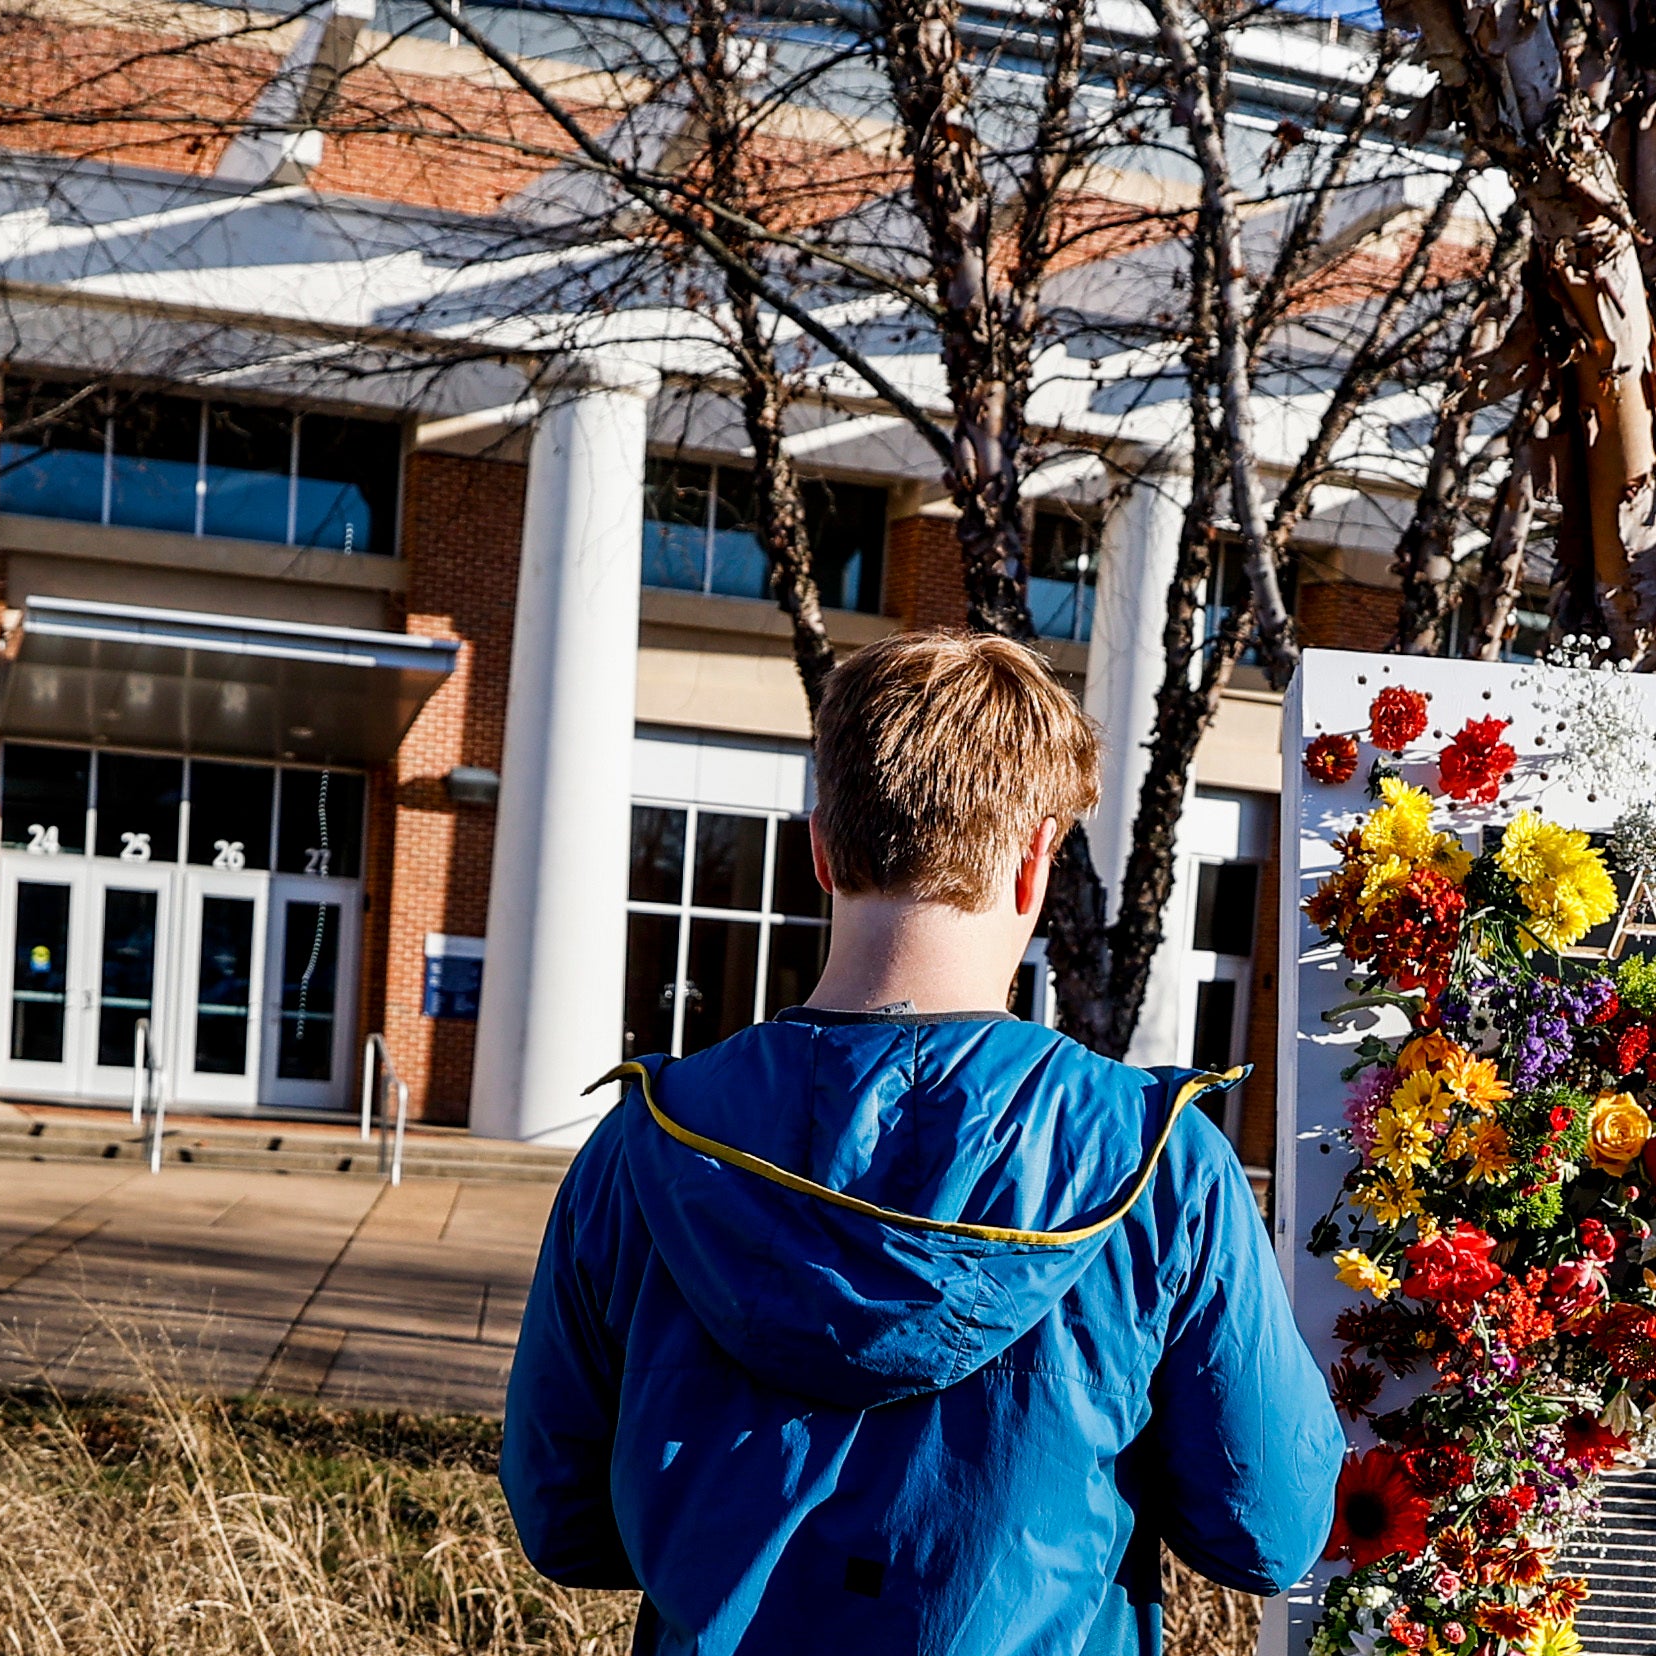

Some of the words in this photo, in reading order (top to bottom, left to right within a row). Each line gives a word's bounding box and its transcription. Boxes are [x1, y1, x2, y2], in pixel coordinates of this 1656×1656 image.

[27, 824, 60, 854] 24
[120, 832, 151, 862] 25
[213, 839, 245, 871] 26
[305, 848, 331, 877] 27
